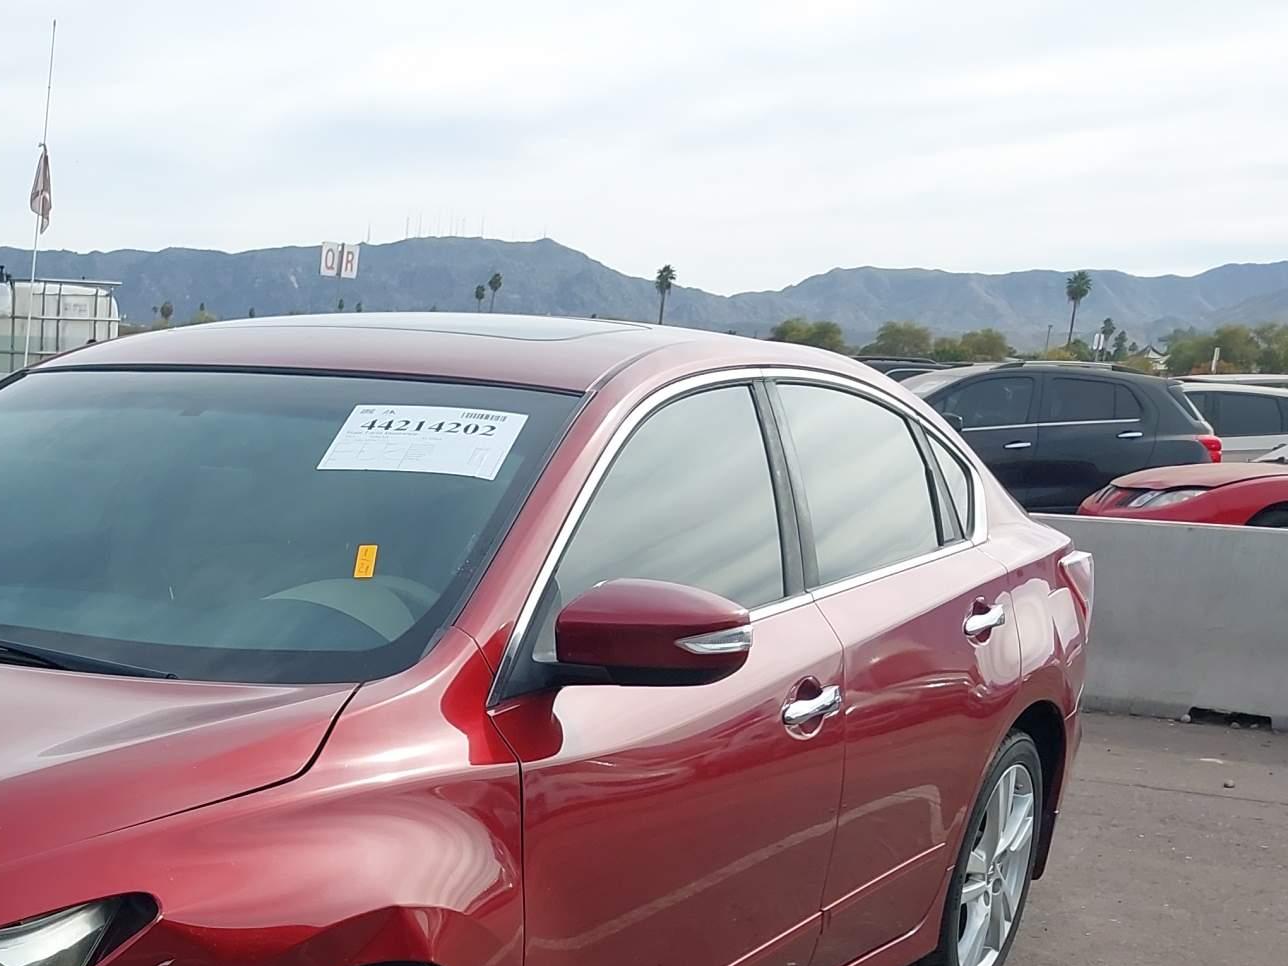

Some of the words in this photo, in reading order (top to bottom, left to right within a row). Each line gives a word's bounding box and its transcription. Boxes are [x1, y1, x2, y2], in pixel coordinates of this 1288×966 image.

[325, 248, 335, 270] Q
[345, 251, 355, 272] R
[361, 418, 497, 437] 44214202
